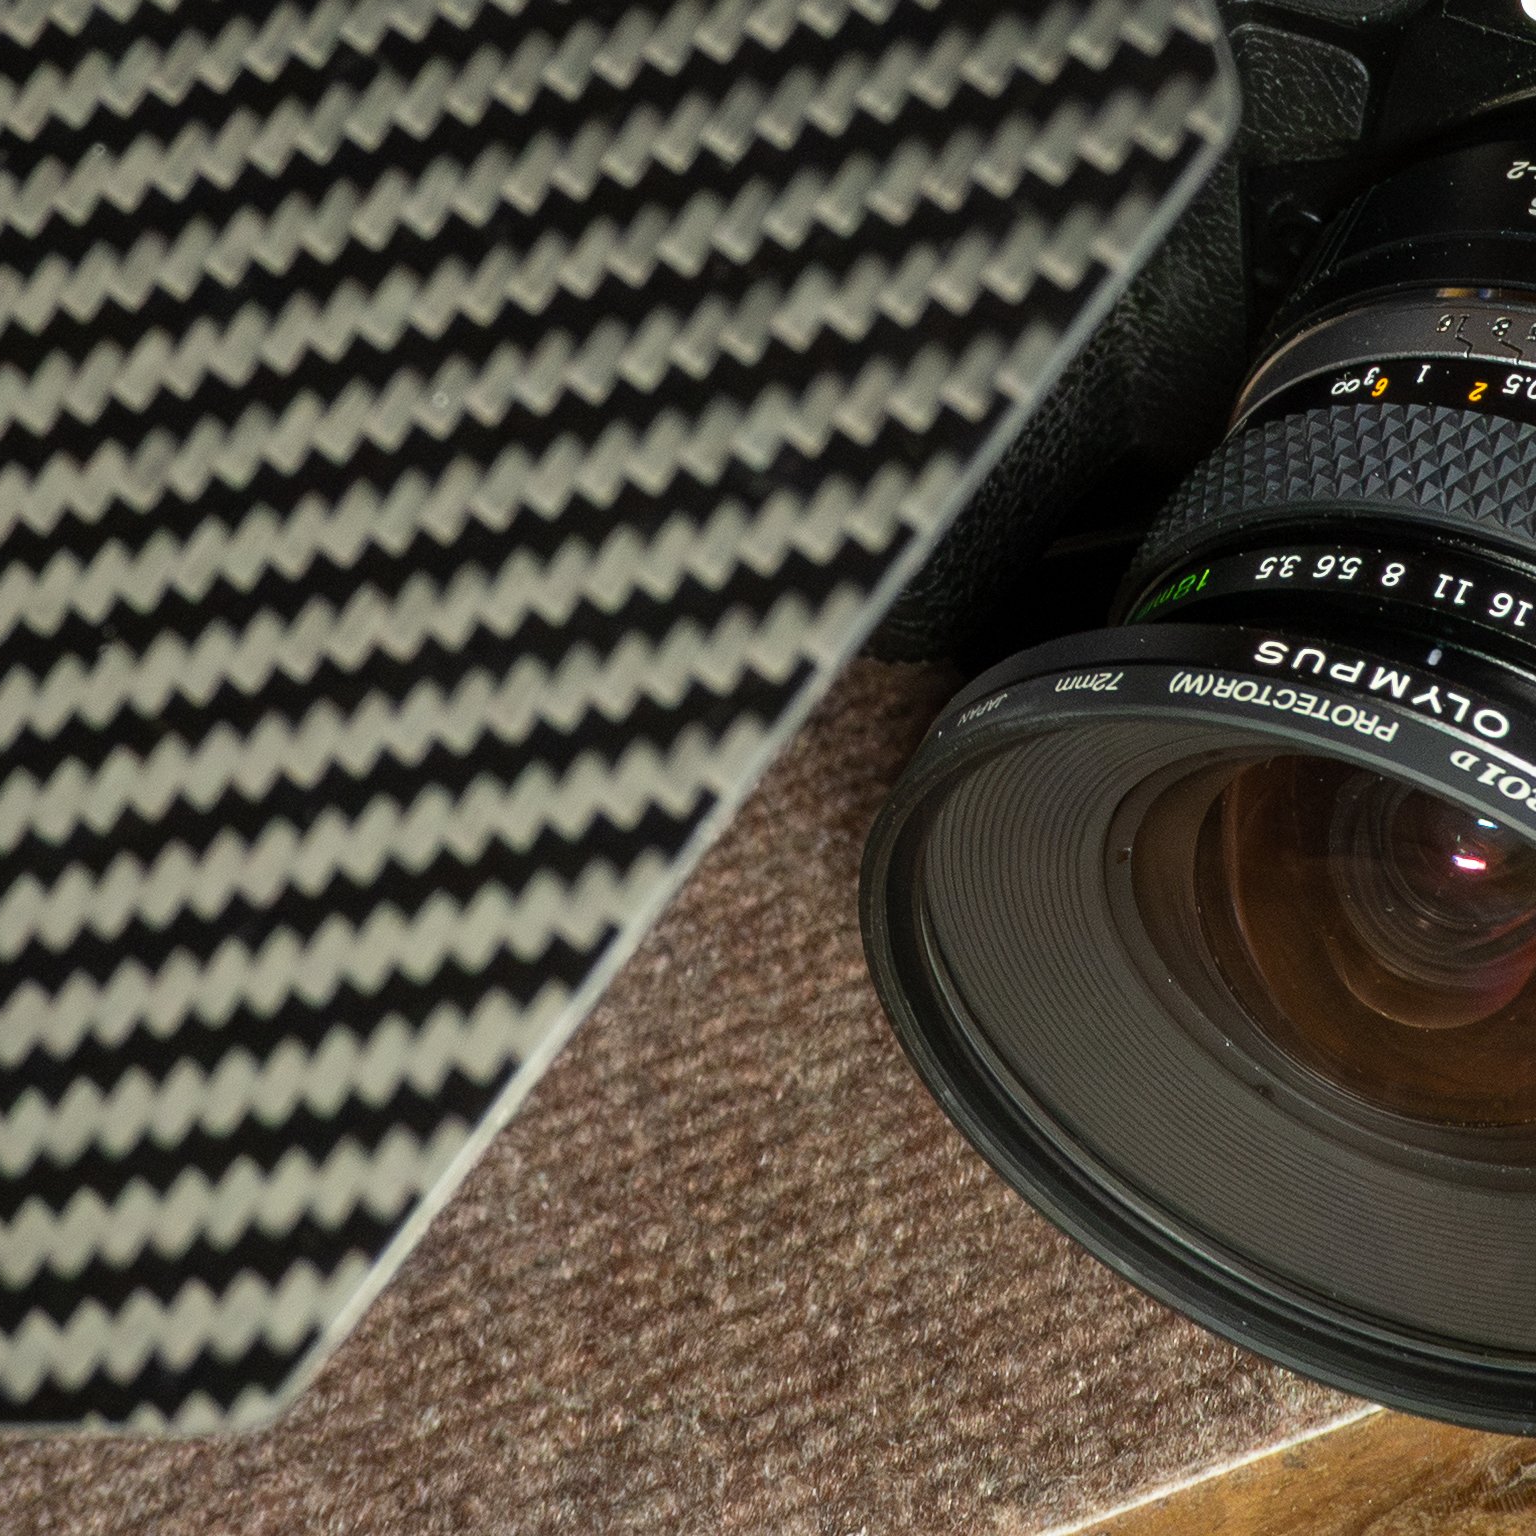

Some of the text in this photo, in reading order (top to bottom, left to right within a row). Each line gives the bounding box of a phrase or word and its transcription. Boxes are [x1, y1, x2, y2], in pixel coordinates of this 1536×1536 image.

[1255, 554, 1302, 580] 3.5
[1312, 554, 1363, 582] 5.6
[1381, 562, 1406, 587] 8
[1433, 573, 1474, 606] 11
[1489, 592, 1534, 628] 16
[1055, 670, 1125, 693] 72mm
[1254, 640, 1510, 739] OLYMPUS
[1169, 671, 1399, 742] PROTECTOR(W)
